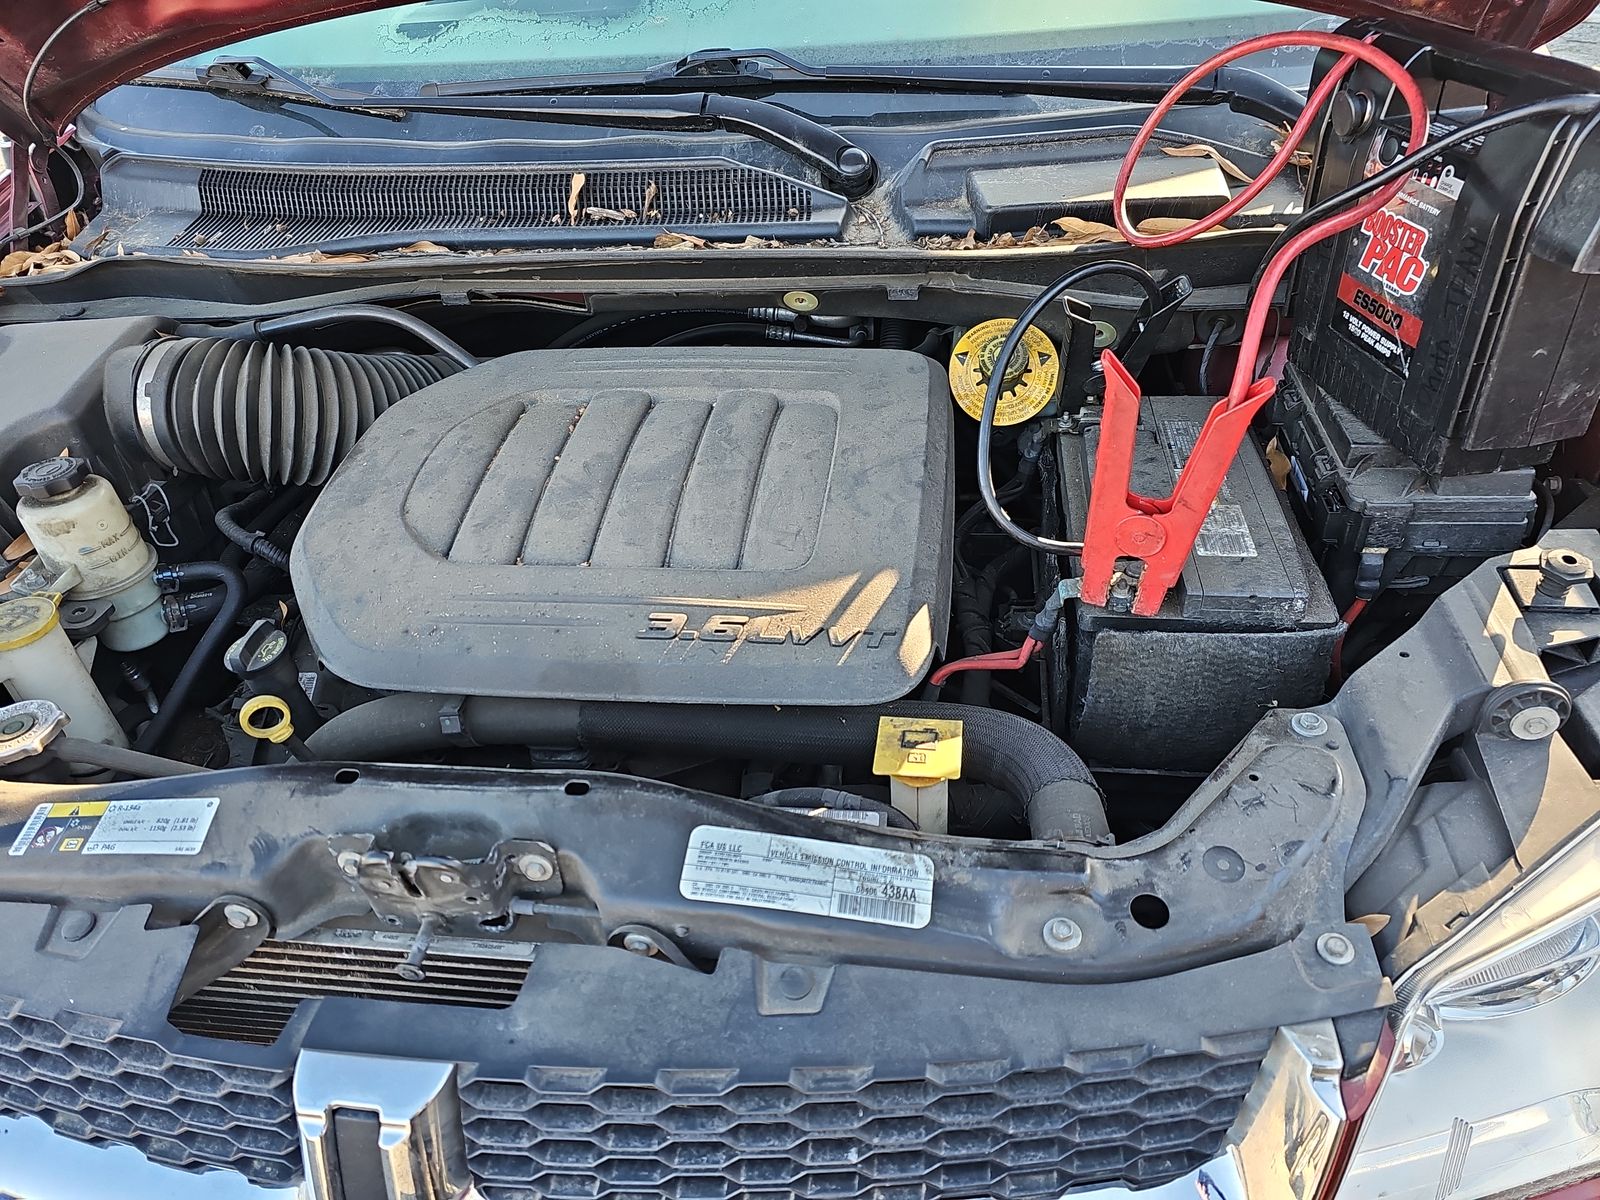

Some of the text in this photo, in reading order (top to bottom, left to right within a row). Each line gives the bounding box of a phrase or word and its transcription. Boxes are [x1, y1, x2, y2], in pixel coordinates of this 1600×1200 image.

[1418, 201, 1441, 217] BATTERY
[1362, 208, 1427, 258] BOOSTER
[1360, 236, 1426, 294] PAC
[1352, 288, 1404, 331] ES5000
[1342, 310, 1402, 355] 12 VOLT POWER SUPPLY
[1360, 332, 1376, 346] PEAK
[1373, 342, 1391, 358] AMPS
[101, 843, 116, 851] PAG
[700, 841, 743, 852] FCA US LLC
[770, 849, 798, 860] VEHICLE
[836, 857, 868, 871] CONTROL
[880, 883, 918, 902] 438AA
